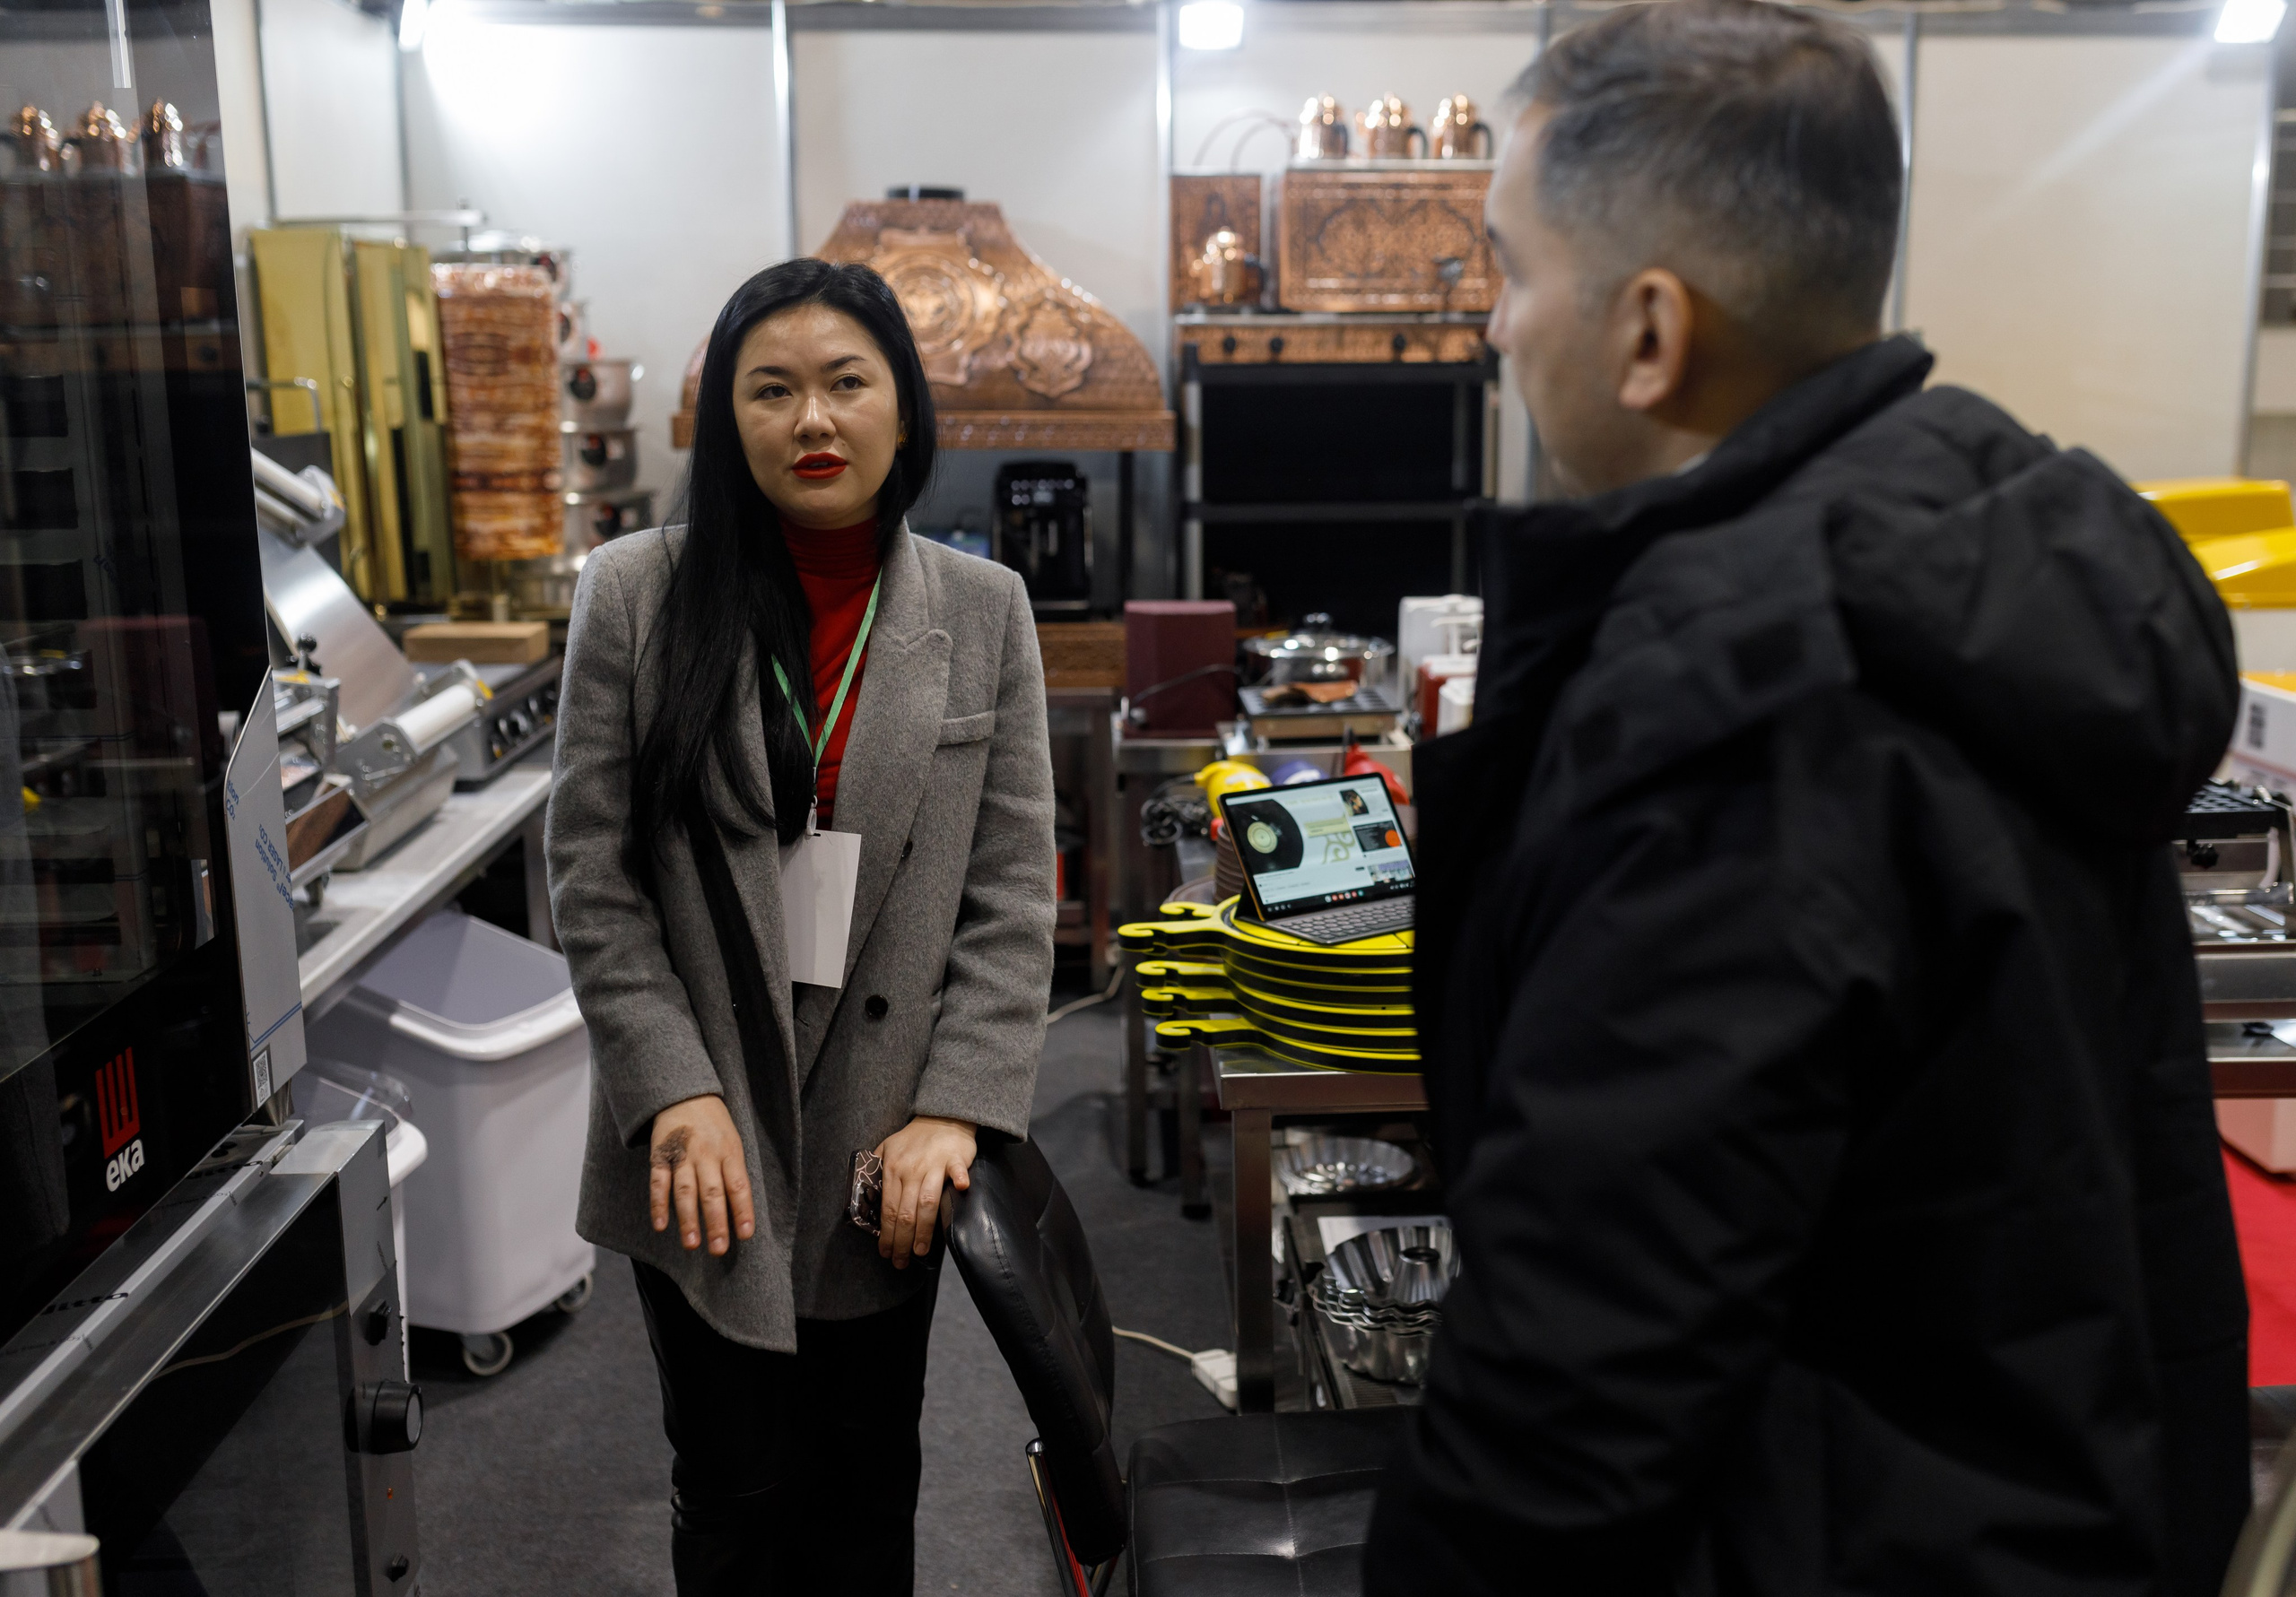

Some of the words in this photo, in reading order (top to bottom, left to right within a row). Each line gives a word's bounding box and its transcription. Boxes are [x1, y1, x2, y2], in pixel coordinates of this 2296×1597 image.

[256, 838, 278, 882] Solution
[268, 839, 283, 872] LASER
[106, 1139, 145, 1193] eka
